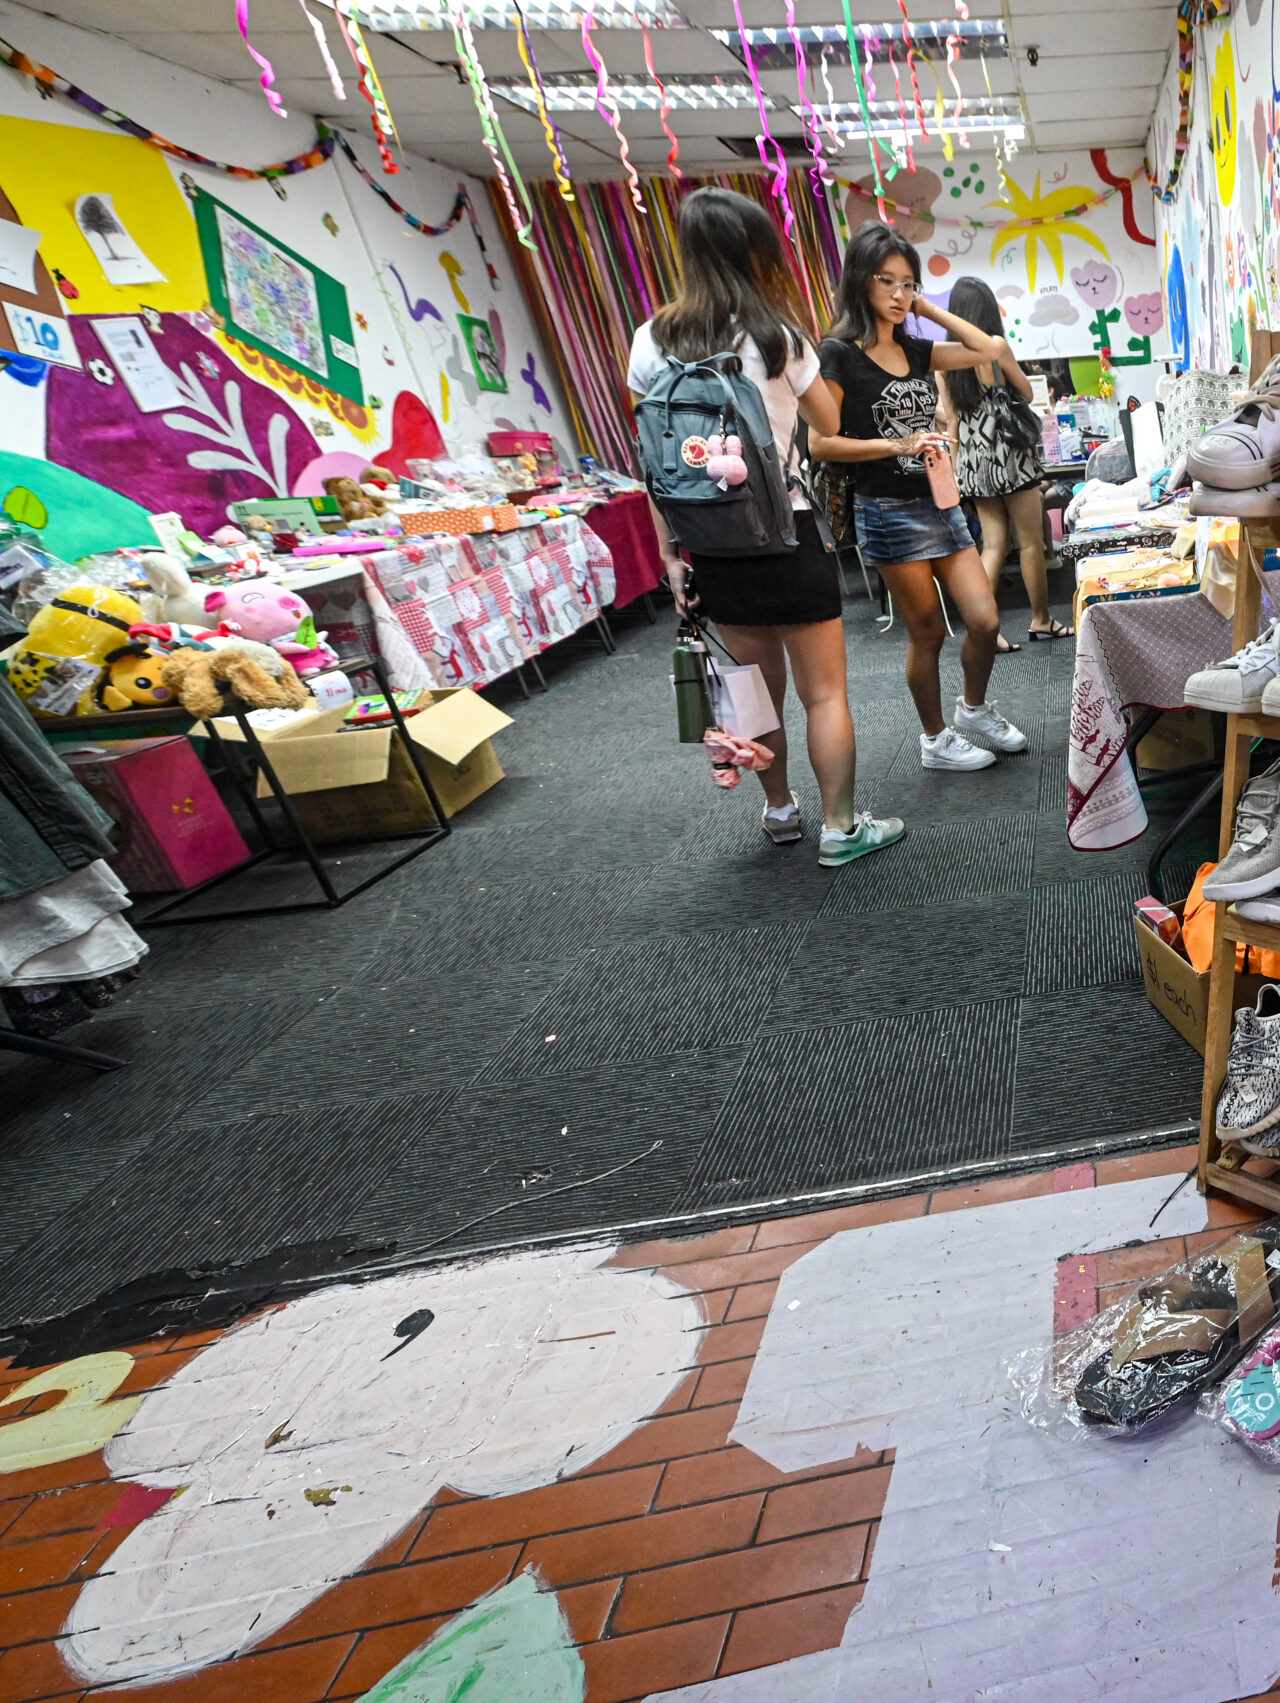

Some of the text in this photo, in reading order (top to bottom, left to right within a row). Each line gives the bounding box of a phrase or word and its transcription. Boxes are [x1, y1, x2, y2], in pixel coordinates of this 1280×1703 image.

[12, 309, 60, 351] $10
[890, 380, 929, 396] TWINKLE
[901, 394, 932, 409] 18 95
[1163, 982, 1198, 1028] each
